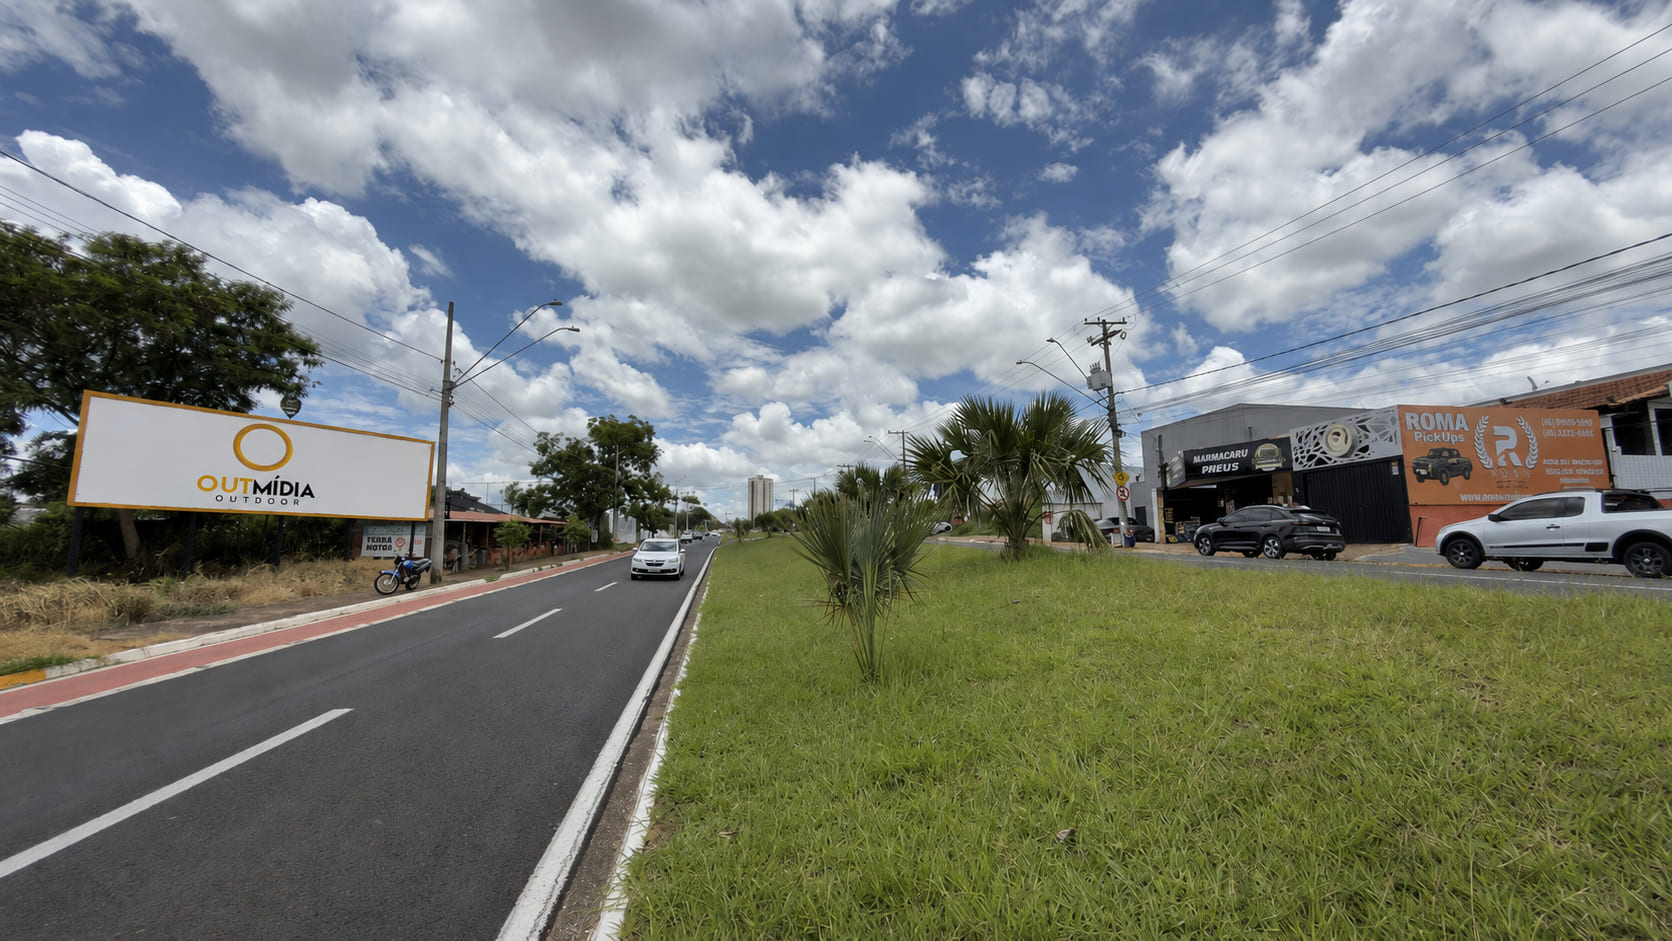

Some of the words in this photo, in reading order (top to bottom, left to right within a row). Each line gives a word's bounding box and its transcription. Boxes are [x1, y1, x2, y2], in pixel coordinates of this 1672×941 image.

[1405, 412, 1470, 431] ROMA
[1414, 431, 1465, 445] PickUps
[1193, 449, 1248, 464] MARMACARU
[1202, 463, 1239, 474] PNEUS
[197, 475, 315, 498] OUTMÍDIA
[215, 495, 299, 505] OUTDOOR
